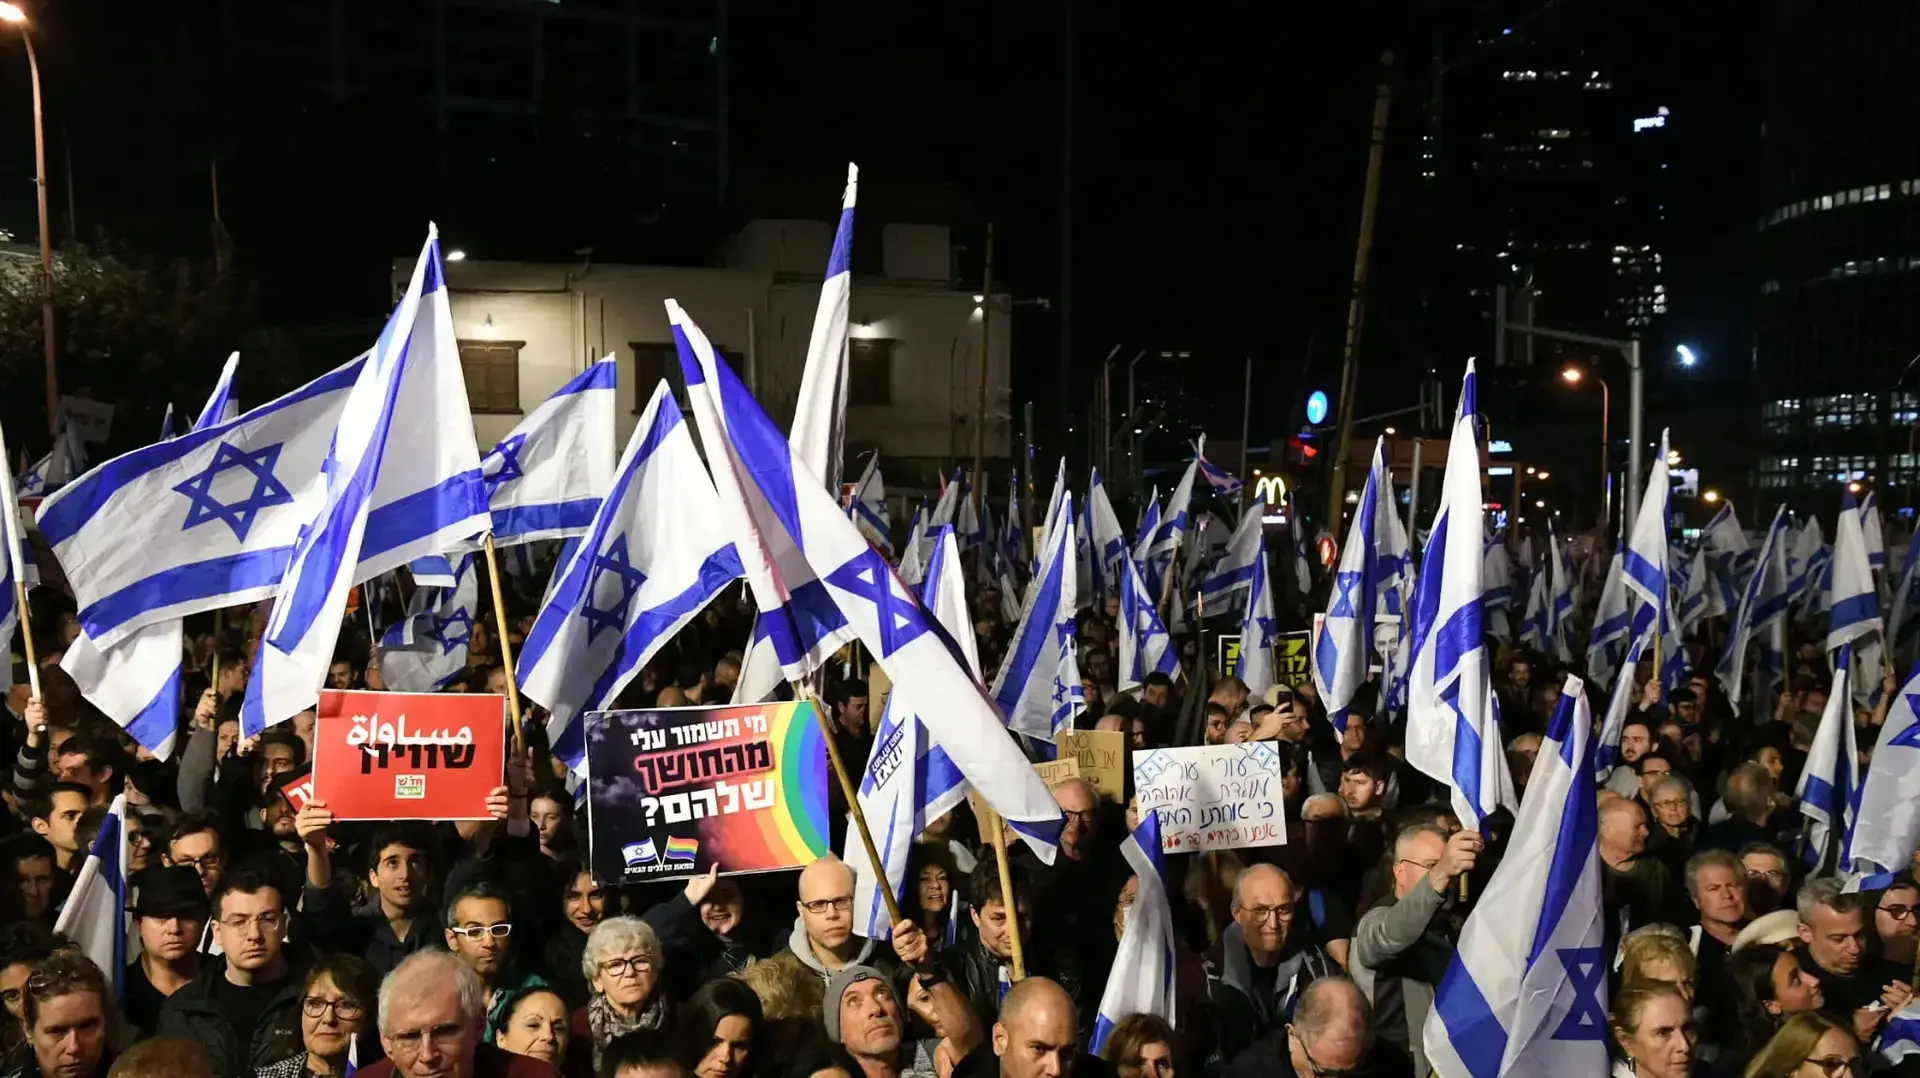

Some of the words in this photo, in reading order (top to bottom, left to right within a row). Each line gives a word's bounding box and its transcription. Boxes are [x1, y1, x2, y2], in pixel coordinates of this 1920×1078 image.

[346, 713, 473, 758] مساواة
[670, 717, 740, 746] תשמור
[744, 714, 768, 733] מי
[630, 728, 666, 751] עלי
[358, 743, 476, 774] שוויון
[637, 740, 771, 791] מהחושך
[1142, 785, 1196, 803] אהובה
[1206, 772, 1269, 804] מולדת
[640, 780, 775, 827] שלהם?
[1257, 801, 1274, 818] כי
